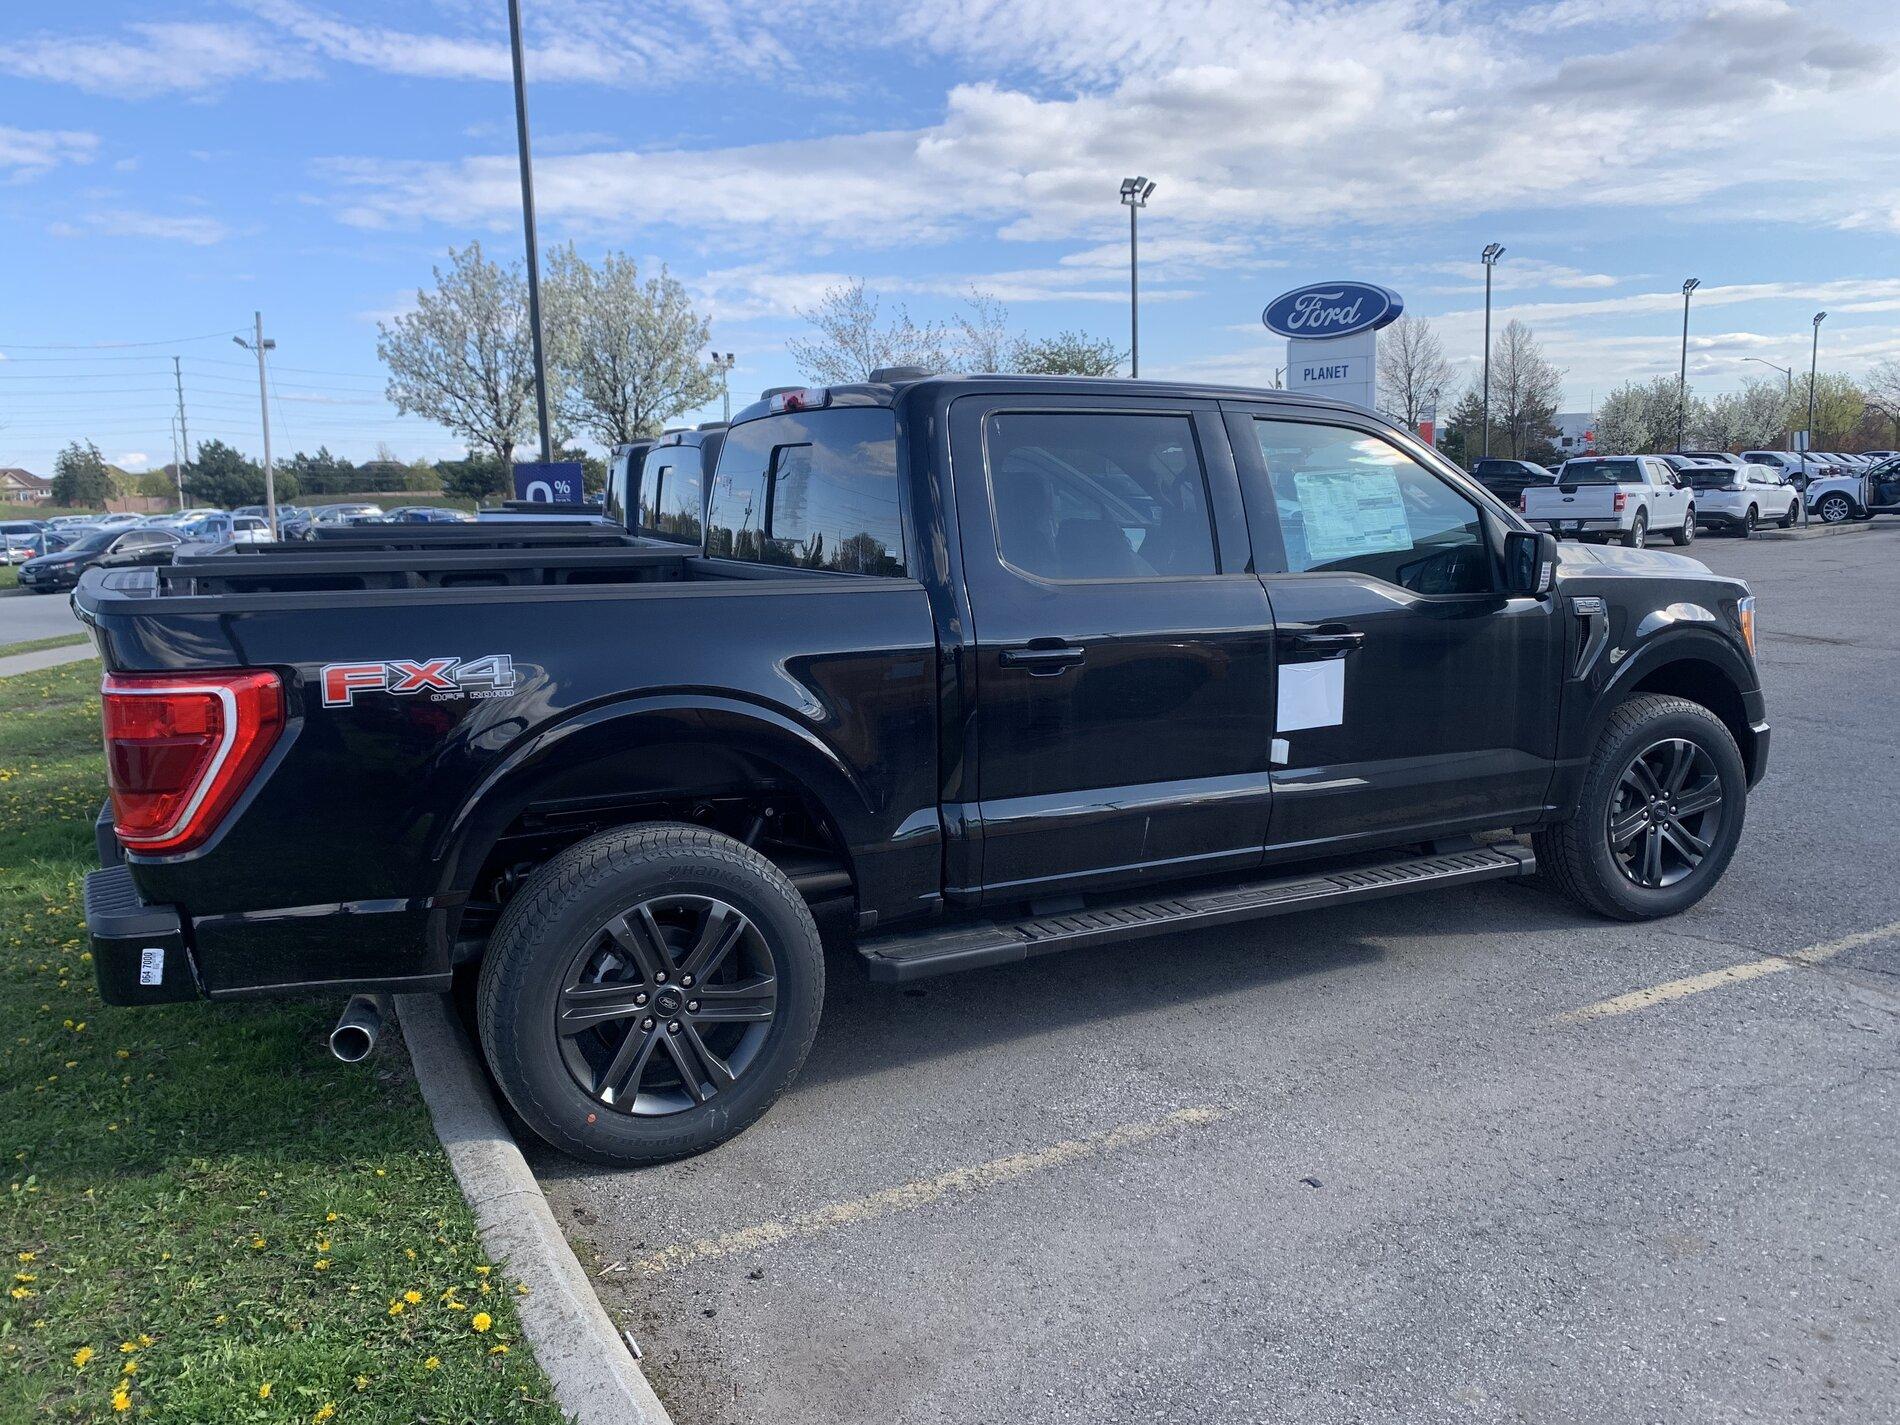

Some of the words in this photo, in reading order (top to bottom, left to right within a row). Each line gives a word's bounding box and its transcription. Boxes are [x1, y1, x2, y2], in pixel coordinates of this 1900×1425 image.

[1287, 291, 1364, 329] Ford
[1303, 364, 1349, 381] PLANET
[320, 654, 516, 708] FX4
[469, 689, 515, 699] ROAD
[142, 952, 153, 969] 7000
